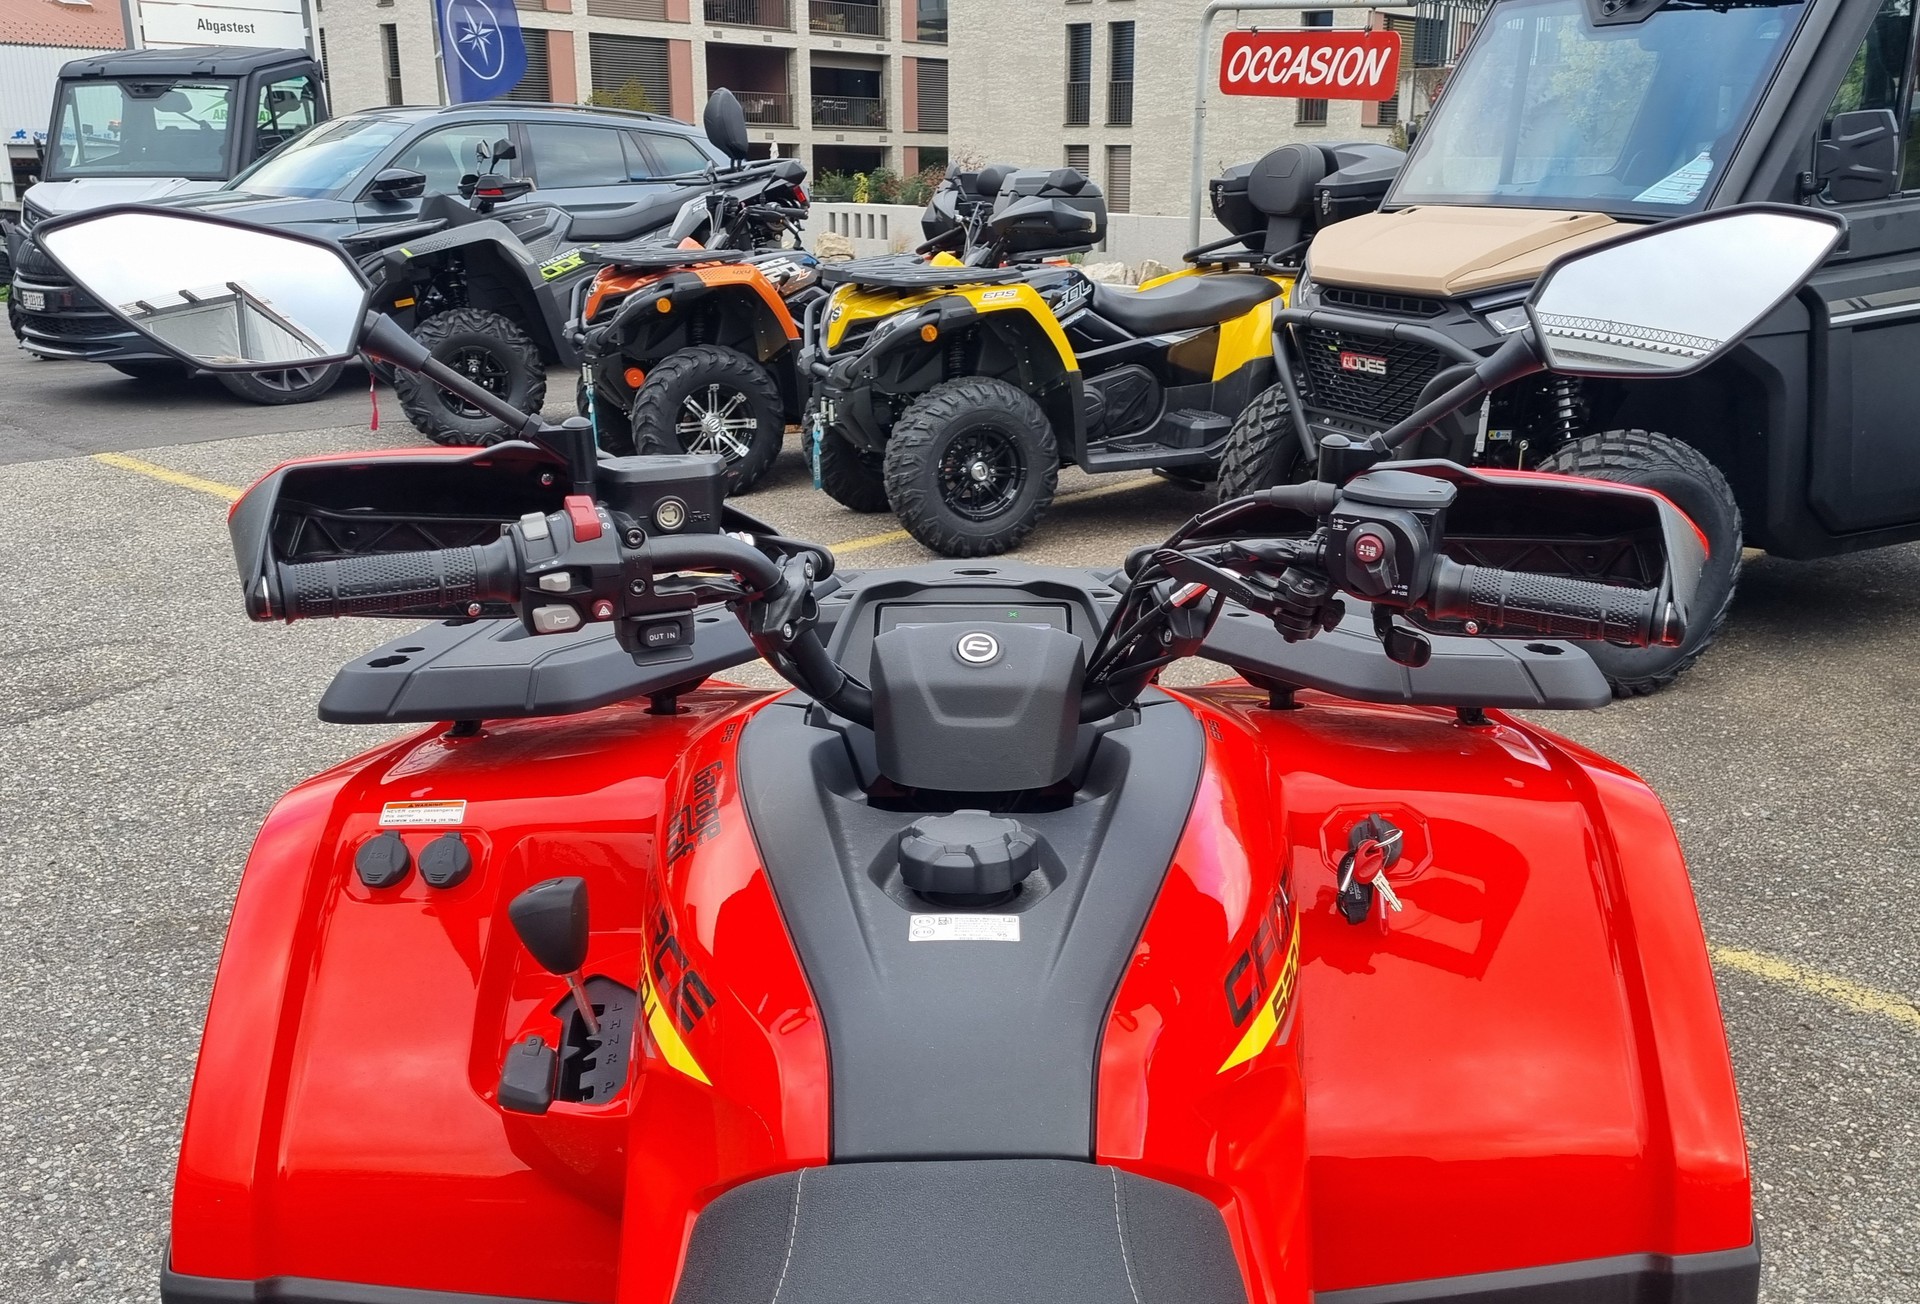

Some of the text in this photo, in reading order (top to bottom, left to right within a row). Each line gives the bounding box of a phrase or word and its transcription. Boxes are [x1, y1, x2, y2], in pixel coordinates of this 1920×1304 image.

[197, 18, 255, 34] Abgastest
[1227, 45, 1391, 86] OCCASION
[649, 632, 677, 641] OUT IN
[688, 761, 722, 847] Garage
[603, 1081, 615, 1094] P
